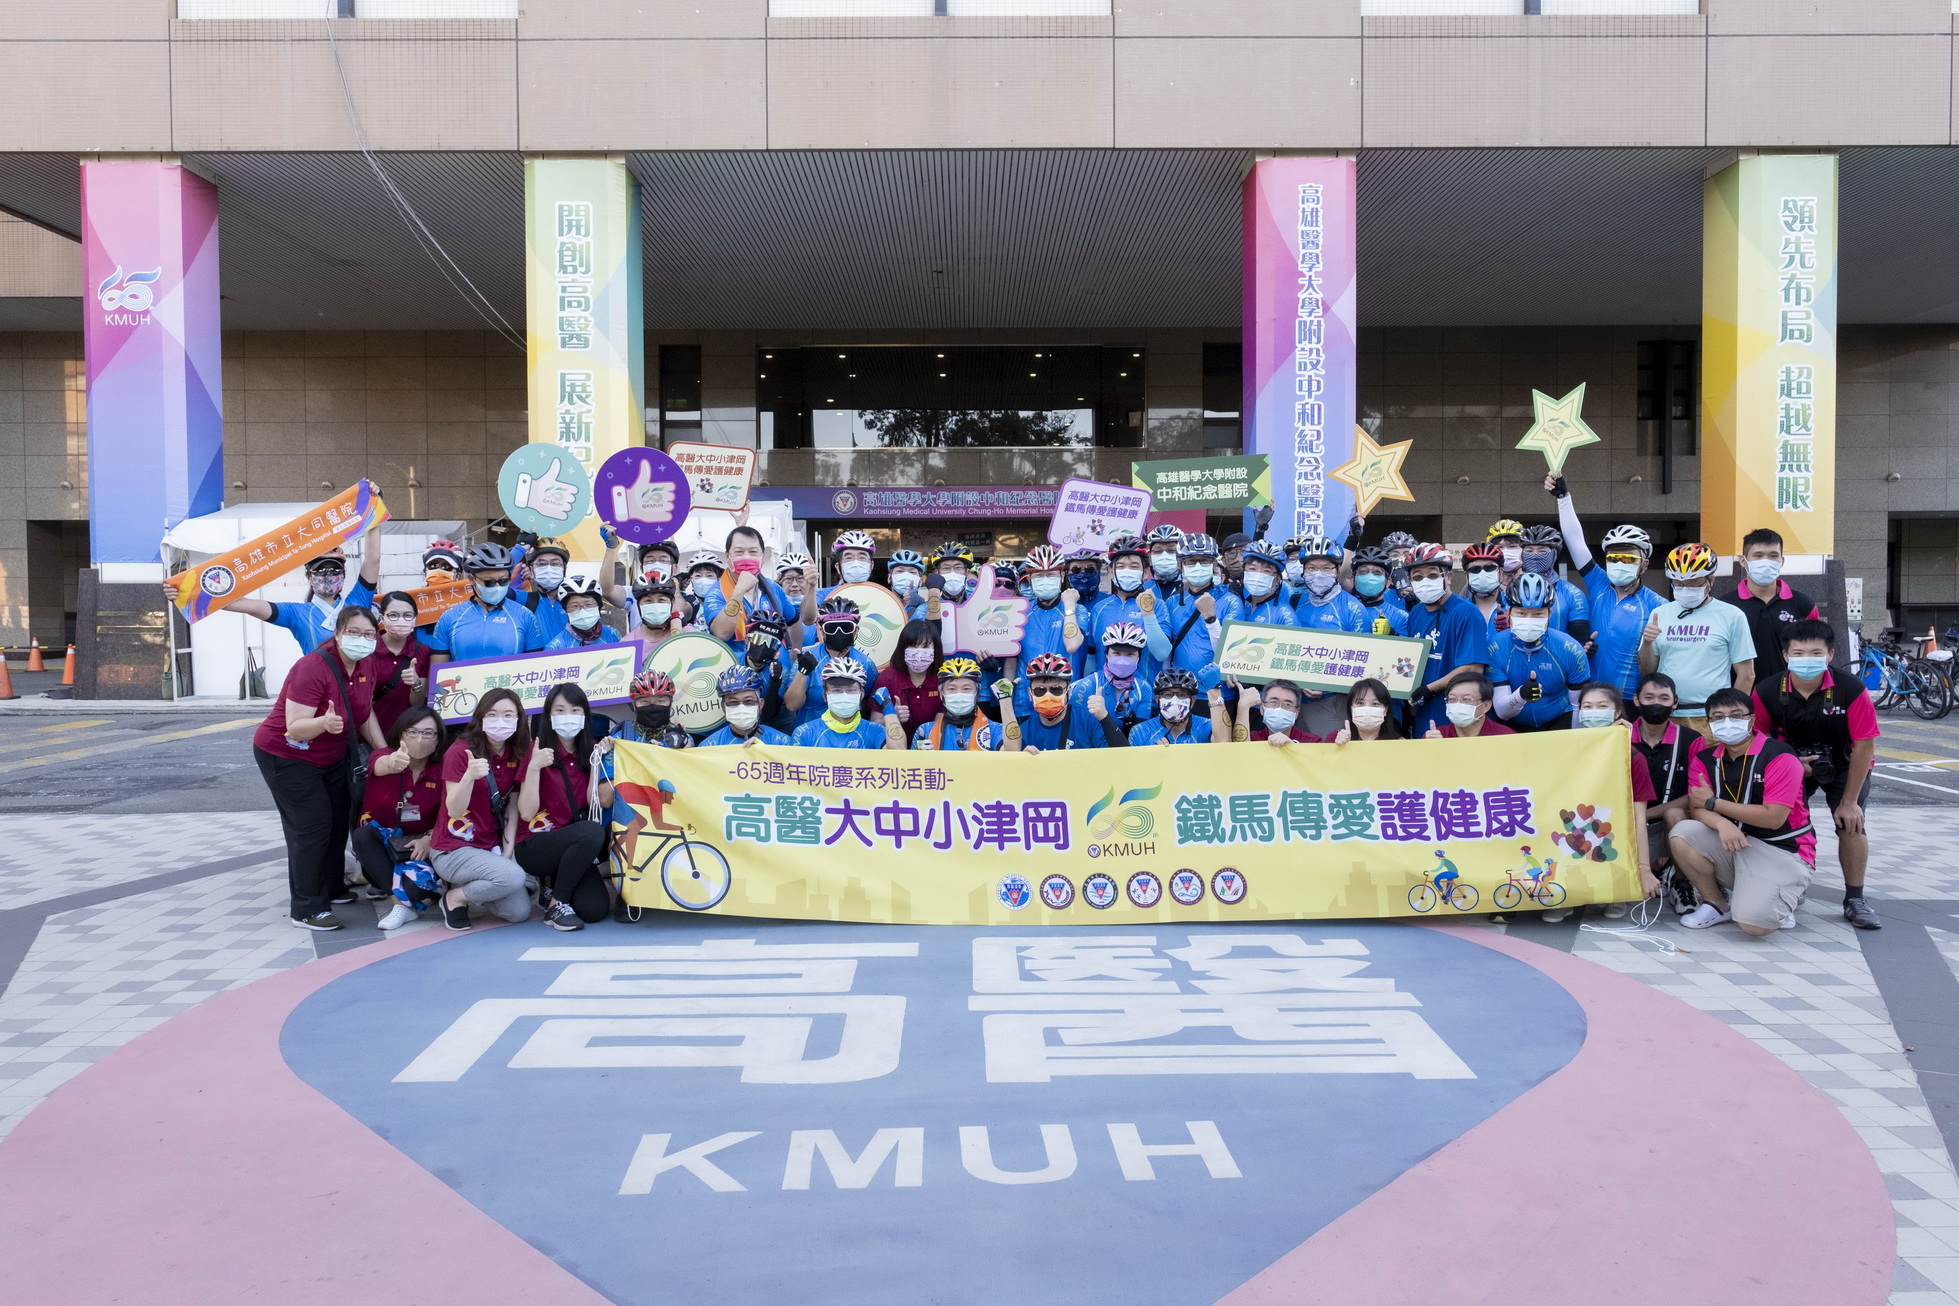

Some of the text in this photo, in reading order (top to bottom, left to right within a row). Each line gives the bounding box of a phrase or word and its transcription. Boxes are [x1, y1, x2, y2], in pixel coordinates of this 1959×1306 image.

[104, 313, 151, 326] KMUH
[556, 203, 594, 516] 開創高醫 展新
[1297, 184, 1324, 535] 高雄醫學大學附設中和紀念醫院
[1777, 197, 1817, 510] 領先布局 超越無限
[675, 452, 746, 465] 高醫大中小津岡
[680, 464, 744, 476] 馬傳愛護健康
[1156, 467, 1248, 484] 高雄醫學大學附設
[863, 491, 1060, 507] 高雄醫學大學附設中和紀念醫
[1068, 490, 1143, 507] 高醫大中小津岡
[1157, 483, 1249, 502] 中和紀念醫院
[863, 508, 901, 516] Kaohsiung
[903, 507, 930, 515] Medical
[932, 507, 966, 516] University
[968, 507, 1004, 516] Chung-Ho
[1005, 507, 1039, 515] Memorial
[1064, 502, 1139, 519] 鐵馬傳愛護健康
[232, 502, 358, 573] 高雄市立大同醫院
[241, 564, 269, 581] Kaohsiung
[268, 551, 293, 568] Municipal
[291, 541, 313, 556] Ta-Tung
[311, 530, 332, 545] Hospital
[759, 624, 779, 634] MASI
[985, 628, 1009, 636] KMUH
[1667, 625, 1710, 636] KMUH
[1273, 642, 1369, 664] 高醫大中小津岡
[1564, 641, 1585, 674] KMUH
[1230, 662, 1261, 672] KMUH
[1269, 657, 1365, 678] 鐵馬傳愛護健康
[484, 665, 580, 689] 高醫大中小津岡
[593, 685, 623, 696] KMUH
[676, 699, 720, 716] KMUH
[729, 761, 954, 791] -65週年院慶系列活動-
[723, 792, 1070, 852] 高醫大中小津岡
[1174, 786, 1535, 846] 鐵馬傳愛護健康
[1102, 841, 1156, 857] KMUH
[392, 935, 1478, 1084] 高醫
[617, 1120, 1243, 1195] KMUH
